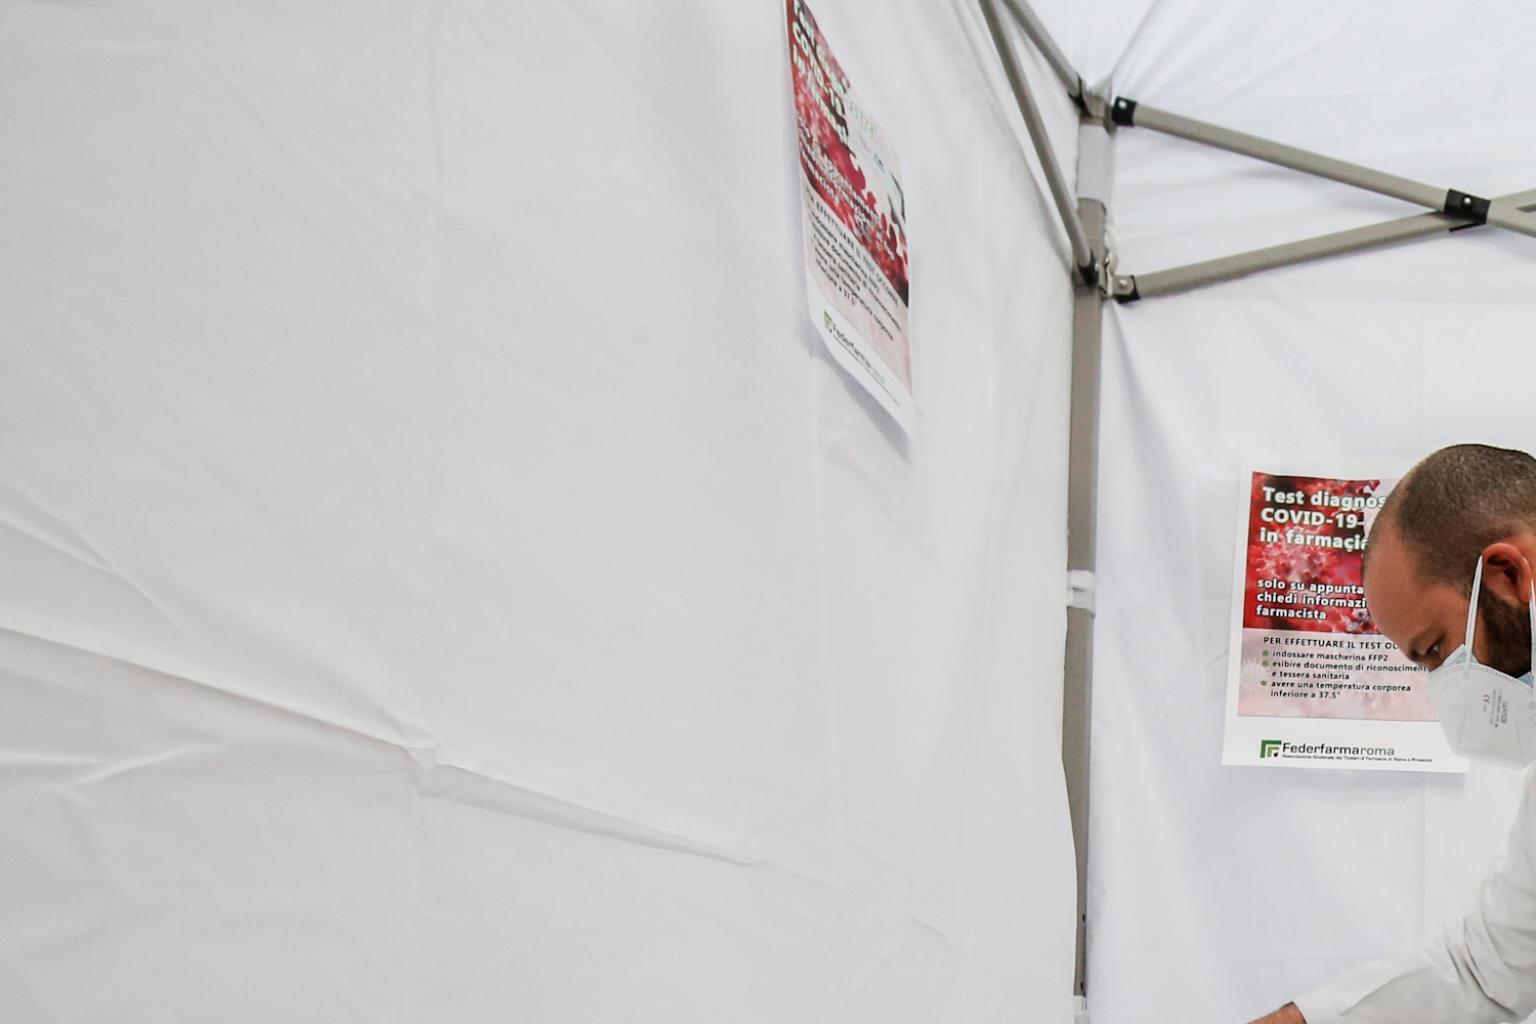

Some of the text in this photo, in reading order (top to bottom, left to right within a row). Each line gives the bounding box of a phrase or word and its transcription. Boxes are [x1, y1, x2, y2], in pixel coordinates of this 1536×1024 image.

[1263, 487, 1386, 510] Test diagnos
[1261, 508, 1358, 528] COVID-19
[1260, 528, 1278, 542] in
[1258, 580, 1364, 595] solo su appunta
[1257, 592, 1297, 604] chiedi
[1256, 605, 1326, 619] farmacista
[1264, 637, 1281, 645] PER
[1285, 638, 1344, 648] EFFETTUARE
[1273, 650, 1314, 658] indossare
[1317, 653, 1365, 661] mascherina
[1304, 662, 1353, 670] documento
[1356, 663, 1364, 671] di
[1313, 672, 1349, 680] sanitaria
[1316, 683, 1370, 691] temperatura
[1271, 690, 1308, 698] inferiore
[1282, 742, 1394, 756] Federfarmaroma
